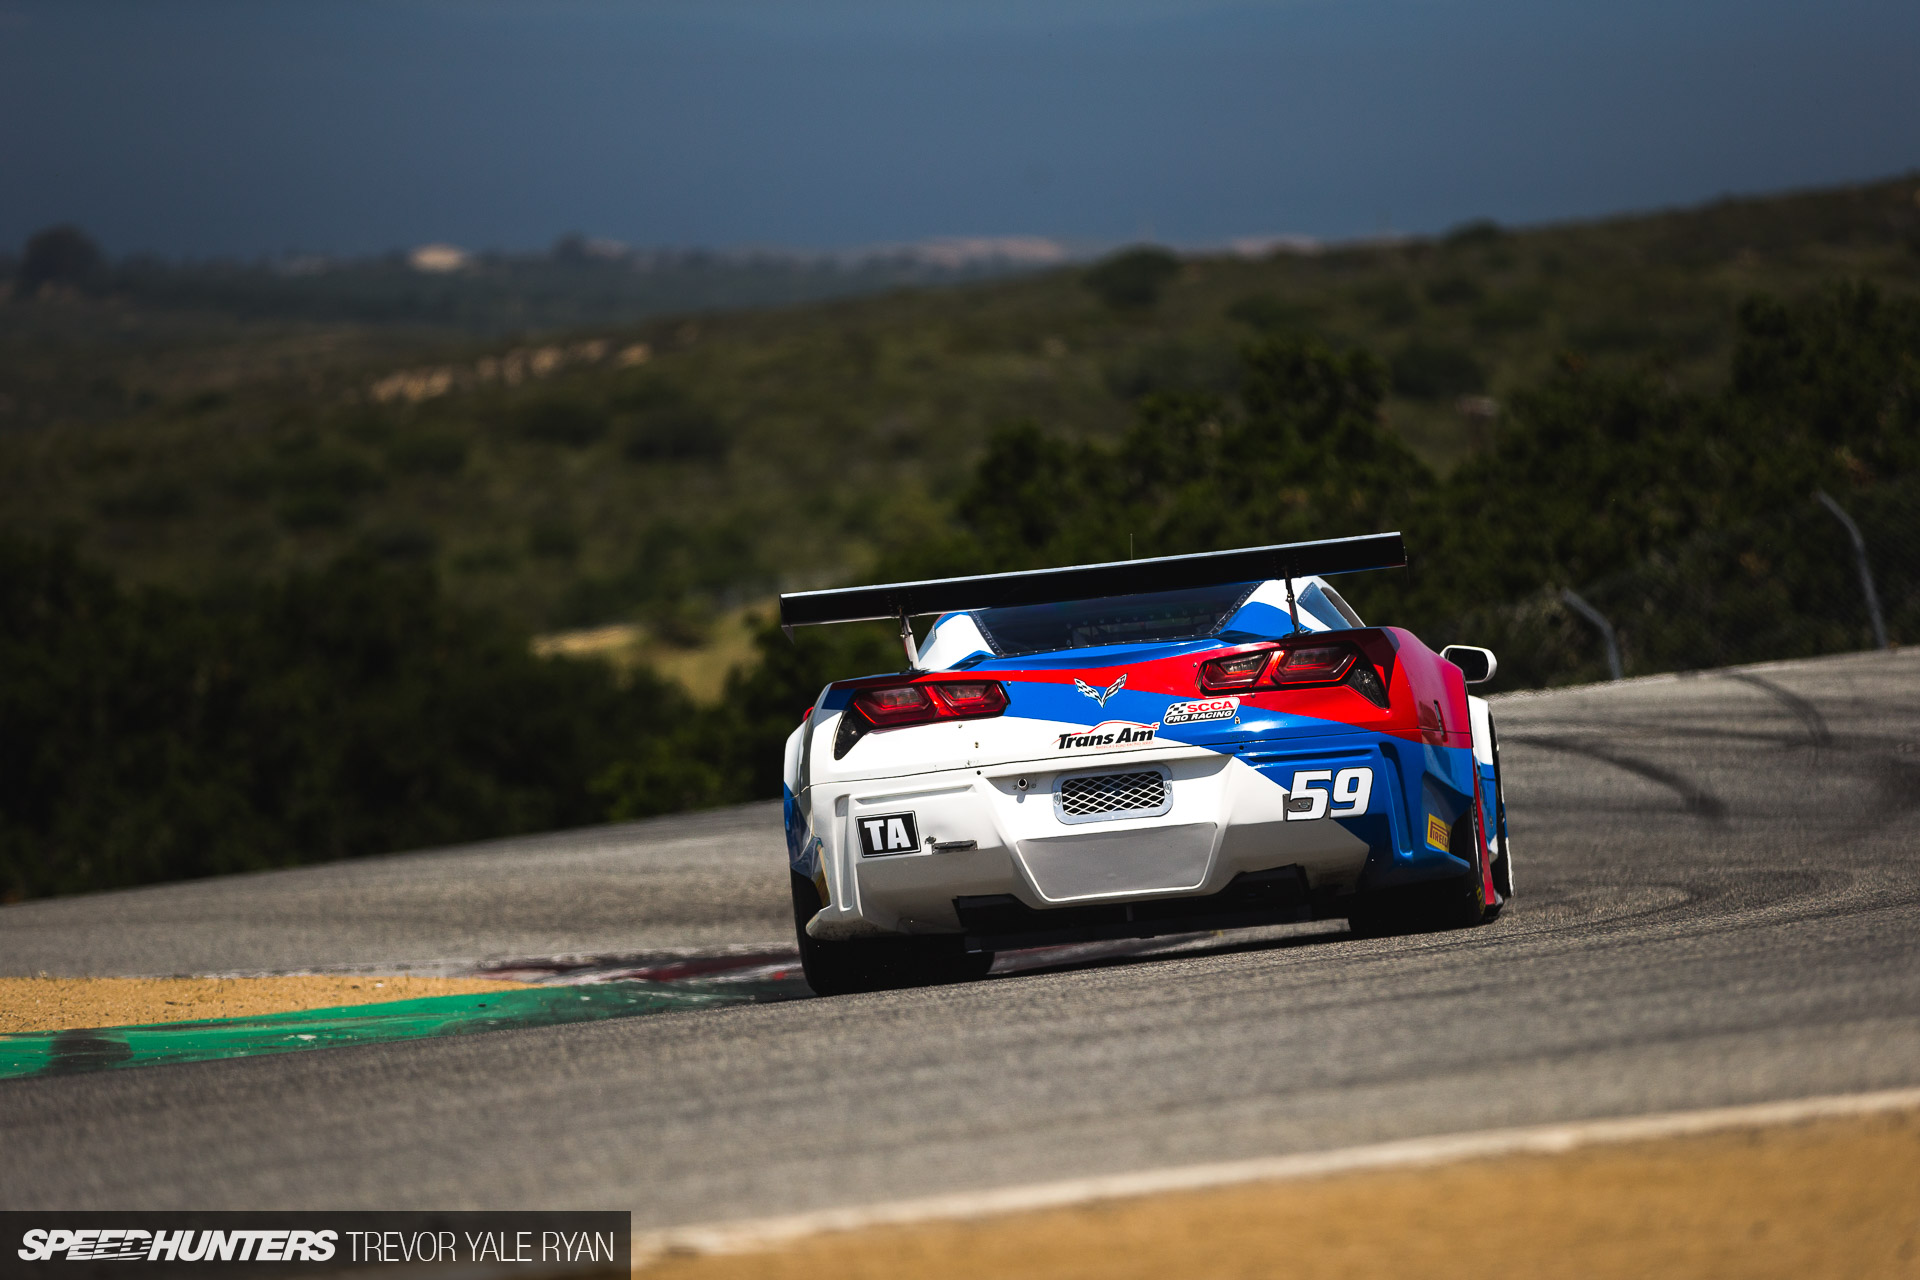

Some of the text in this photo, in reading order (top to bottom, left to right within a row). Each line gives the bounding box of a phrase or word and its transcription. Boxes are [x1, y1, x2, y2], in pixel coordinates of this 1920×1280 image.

[1167, 711, 1232, 723] PRO RACING
[1187, 701, 1233, 712] SCCA
[1059, 728, 1154, 749] Trans Am
[1286, 766, 1374, 821] 59
[864, 818, 911, 851] TA
